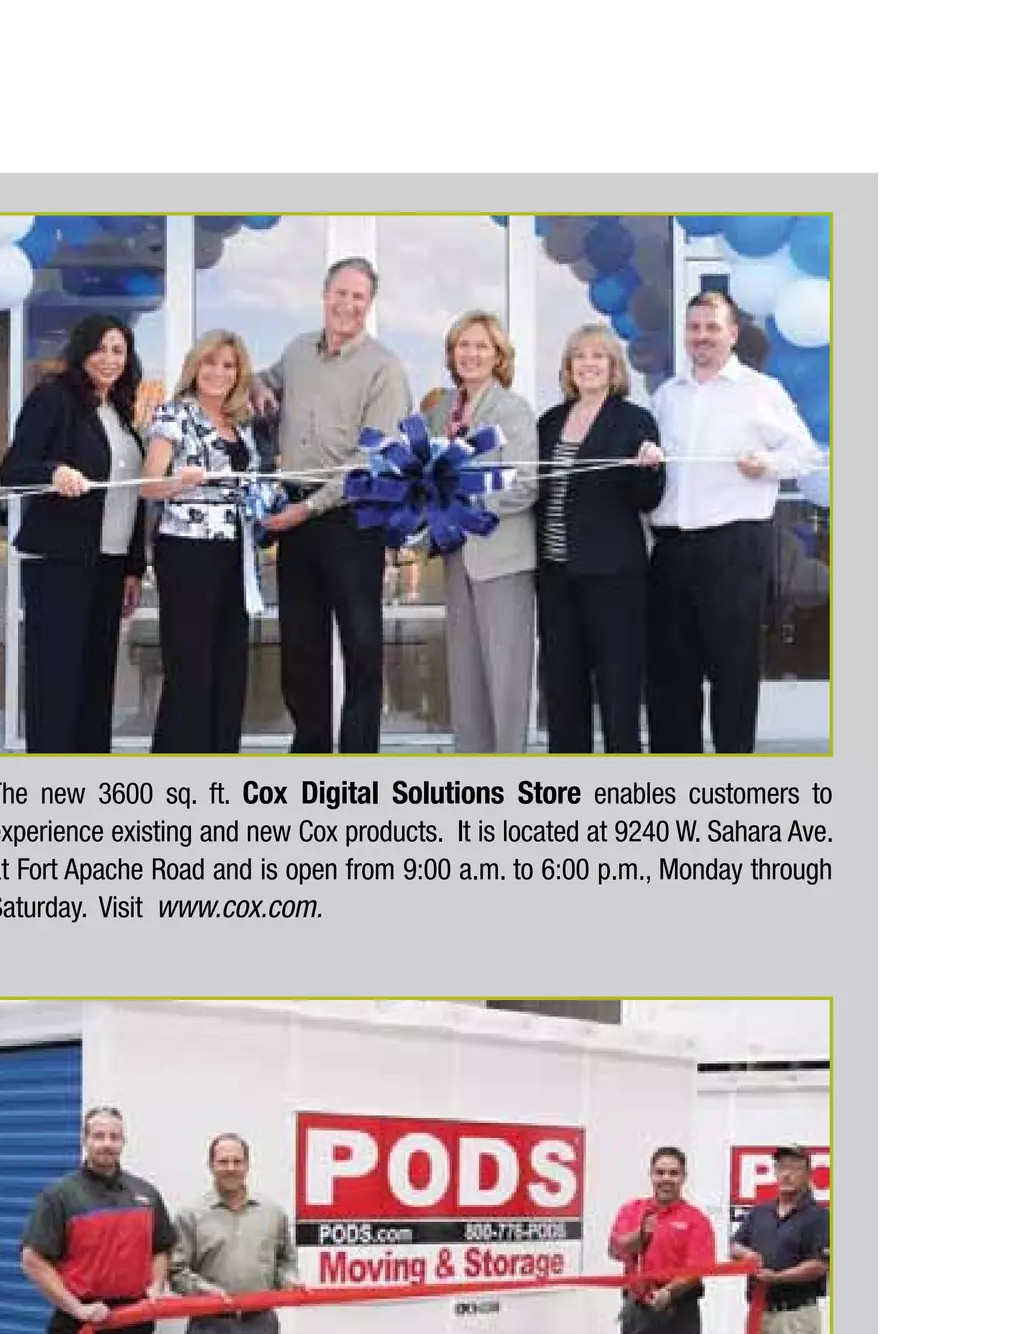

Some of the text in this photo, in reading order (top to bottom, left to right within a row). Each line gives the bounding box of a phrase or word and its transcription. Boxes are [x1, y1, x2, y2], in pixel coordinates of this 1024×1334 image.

[41, 786, 86, 805] new
[98, 781, 154, 805] 3600
[166, 786, 197, 810] sq.
[208, 781, 230, 805] ft.
[242, 780, 288, 805] Cox
[301, 780, 379, 810] Digital
[391, 780, 505, 805] Solutions
[517, 780, 582, 805] Store
[594, 781, 677, 805] enables
[688, 782, 800, 805] customers
[811, 782, 833, 805] to
[98, 895, 144, 919] Visit
[158, 899, 322, 919] www.cox.com.
[305, 1127, 578, 1208] PODS
[319, 1222, 413, 1246] PODS.com
[320, 1246, 565, 1285] Moving & Storage
